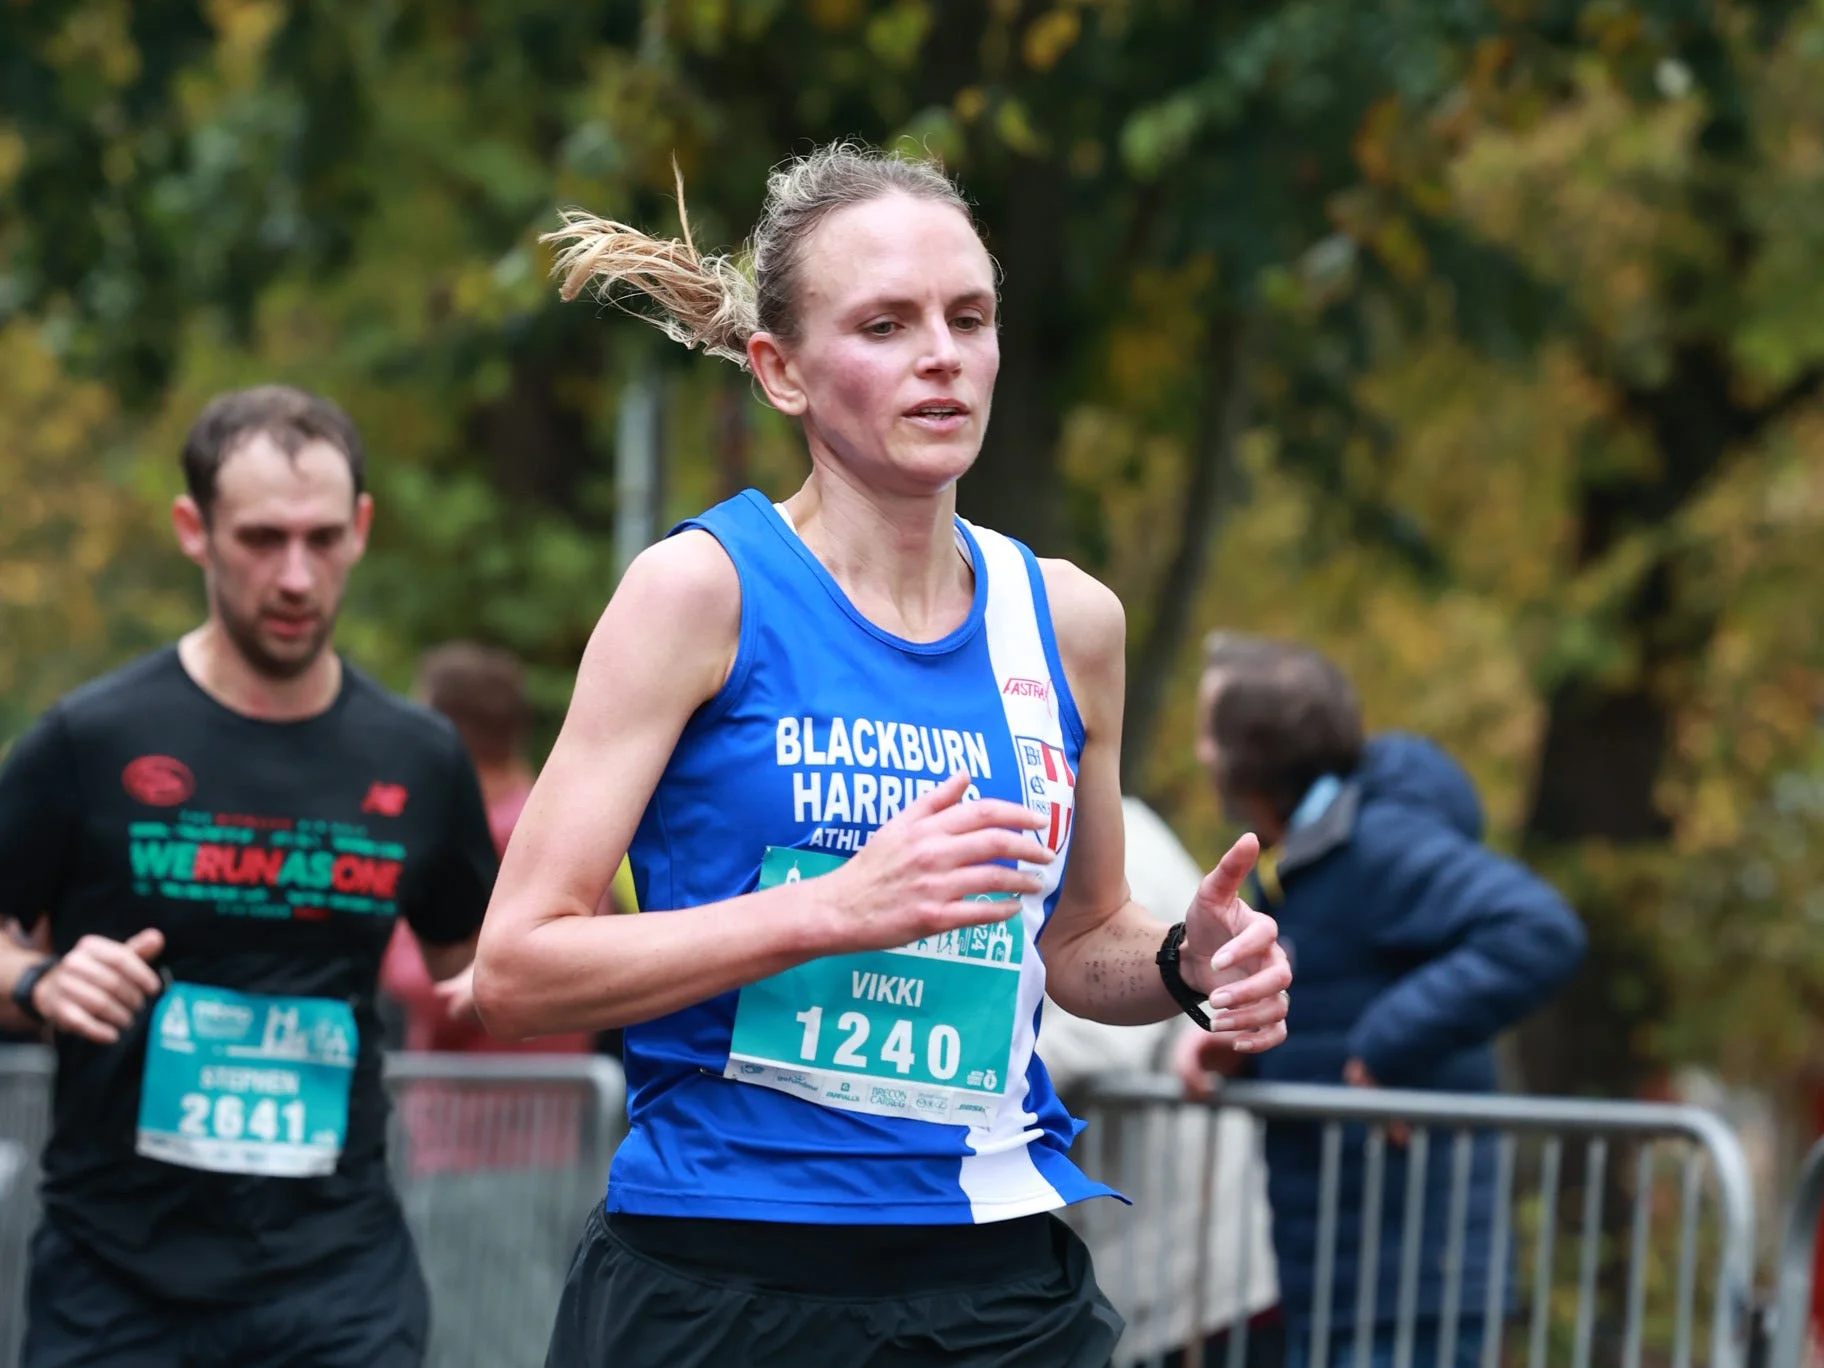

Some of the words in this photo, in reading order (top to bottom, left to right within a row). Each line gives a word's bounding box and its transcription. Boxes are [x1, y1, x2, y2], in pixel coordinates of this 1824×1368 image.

[776, 717, 992, 779] BLACKBURN
[793, 772, 981, 825] HARRI
[852, 970, 924, 1007] VIKKI
[796, 1005, 961, 1080] 1240
[178, 1092, 305, 1141] 2641
